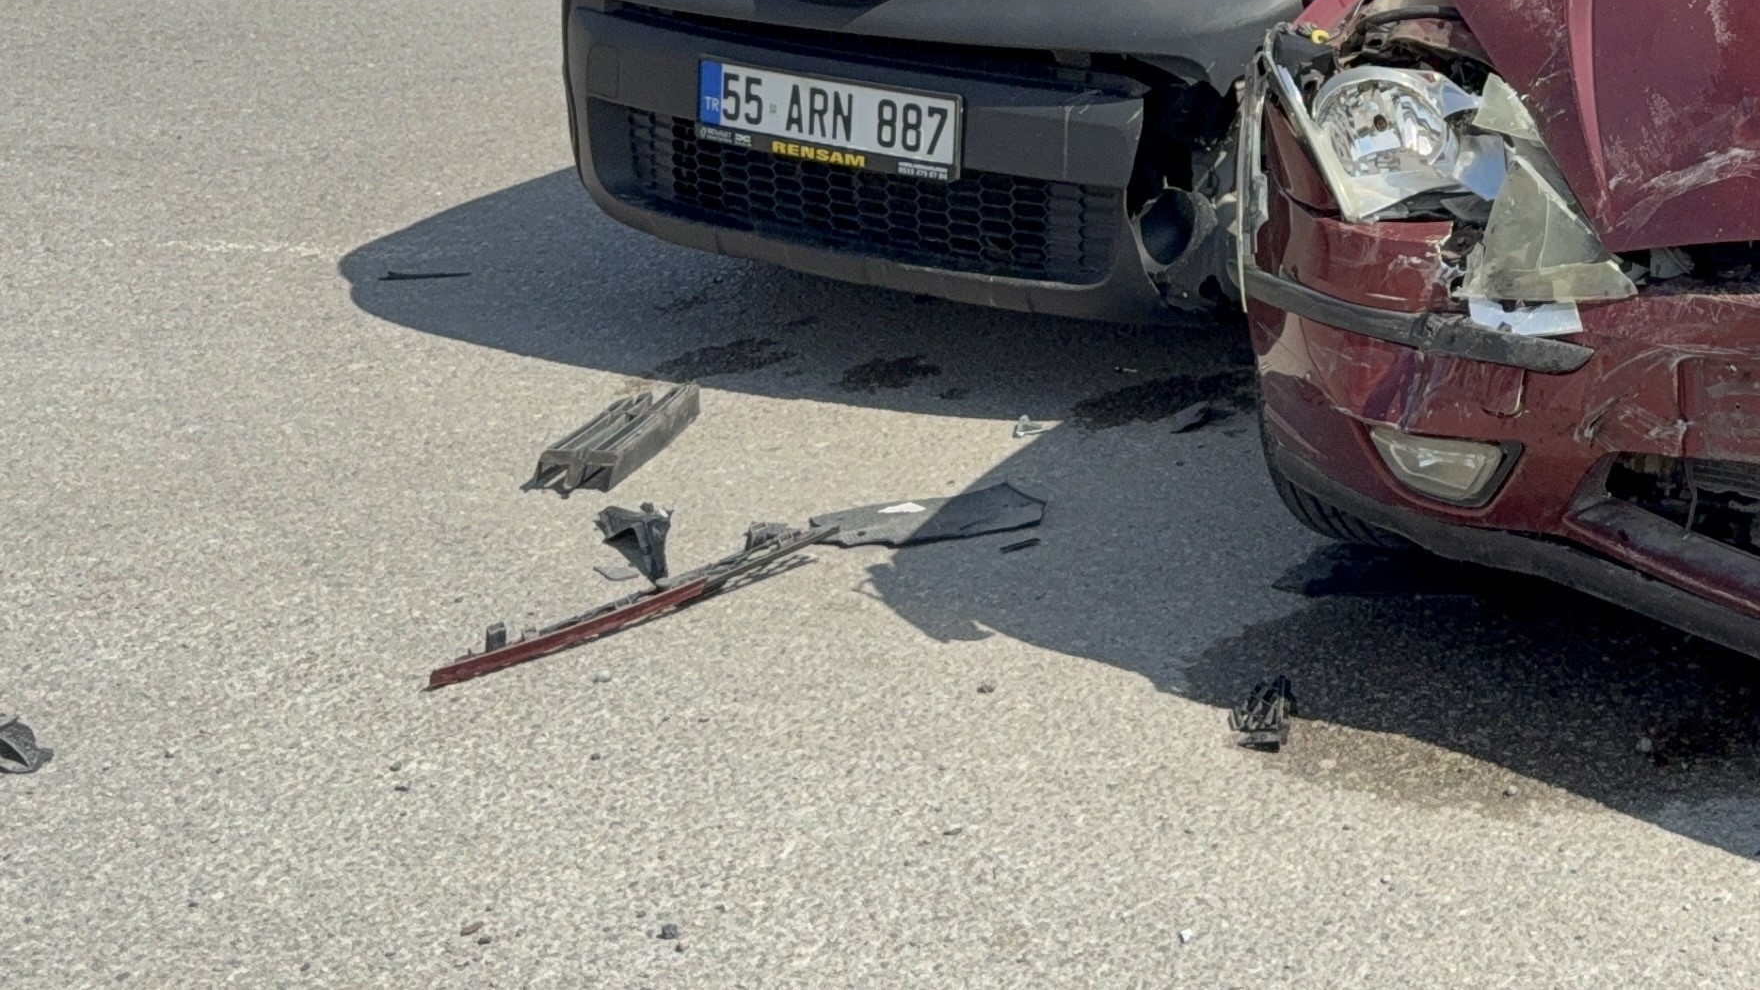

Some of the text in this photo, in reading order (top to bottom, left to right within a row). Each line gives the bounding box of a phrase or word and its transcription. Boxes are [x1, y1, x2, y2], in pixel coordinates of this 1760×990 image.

[704, 95, 720, 112] TR
[722, 71, 949, 156] 55 ARN 887
[771, 139, 866, 169] RENSAM
